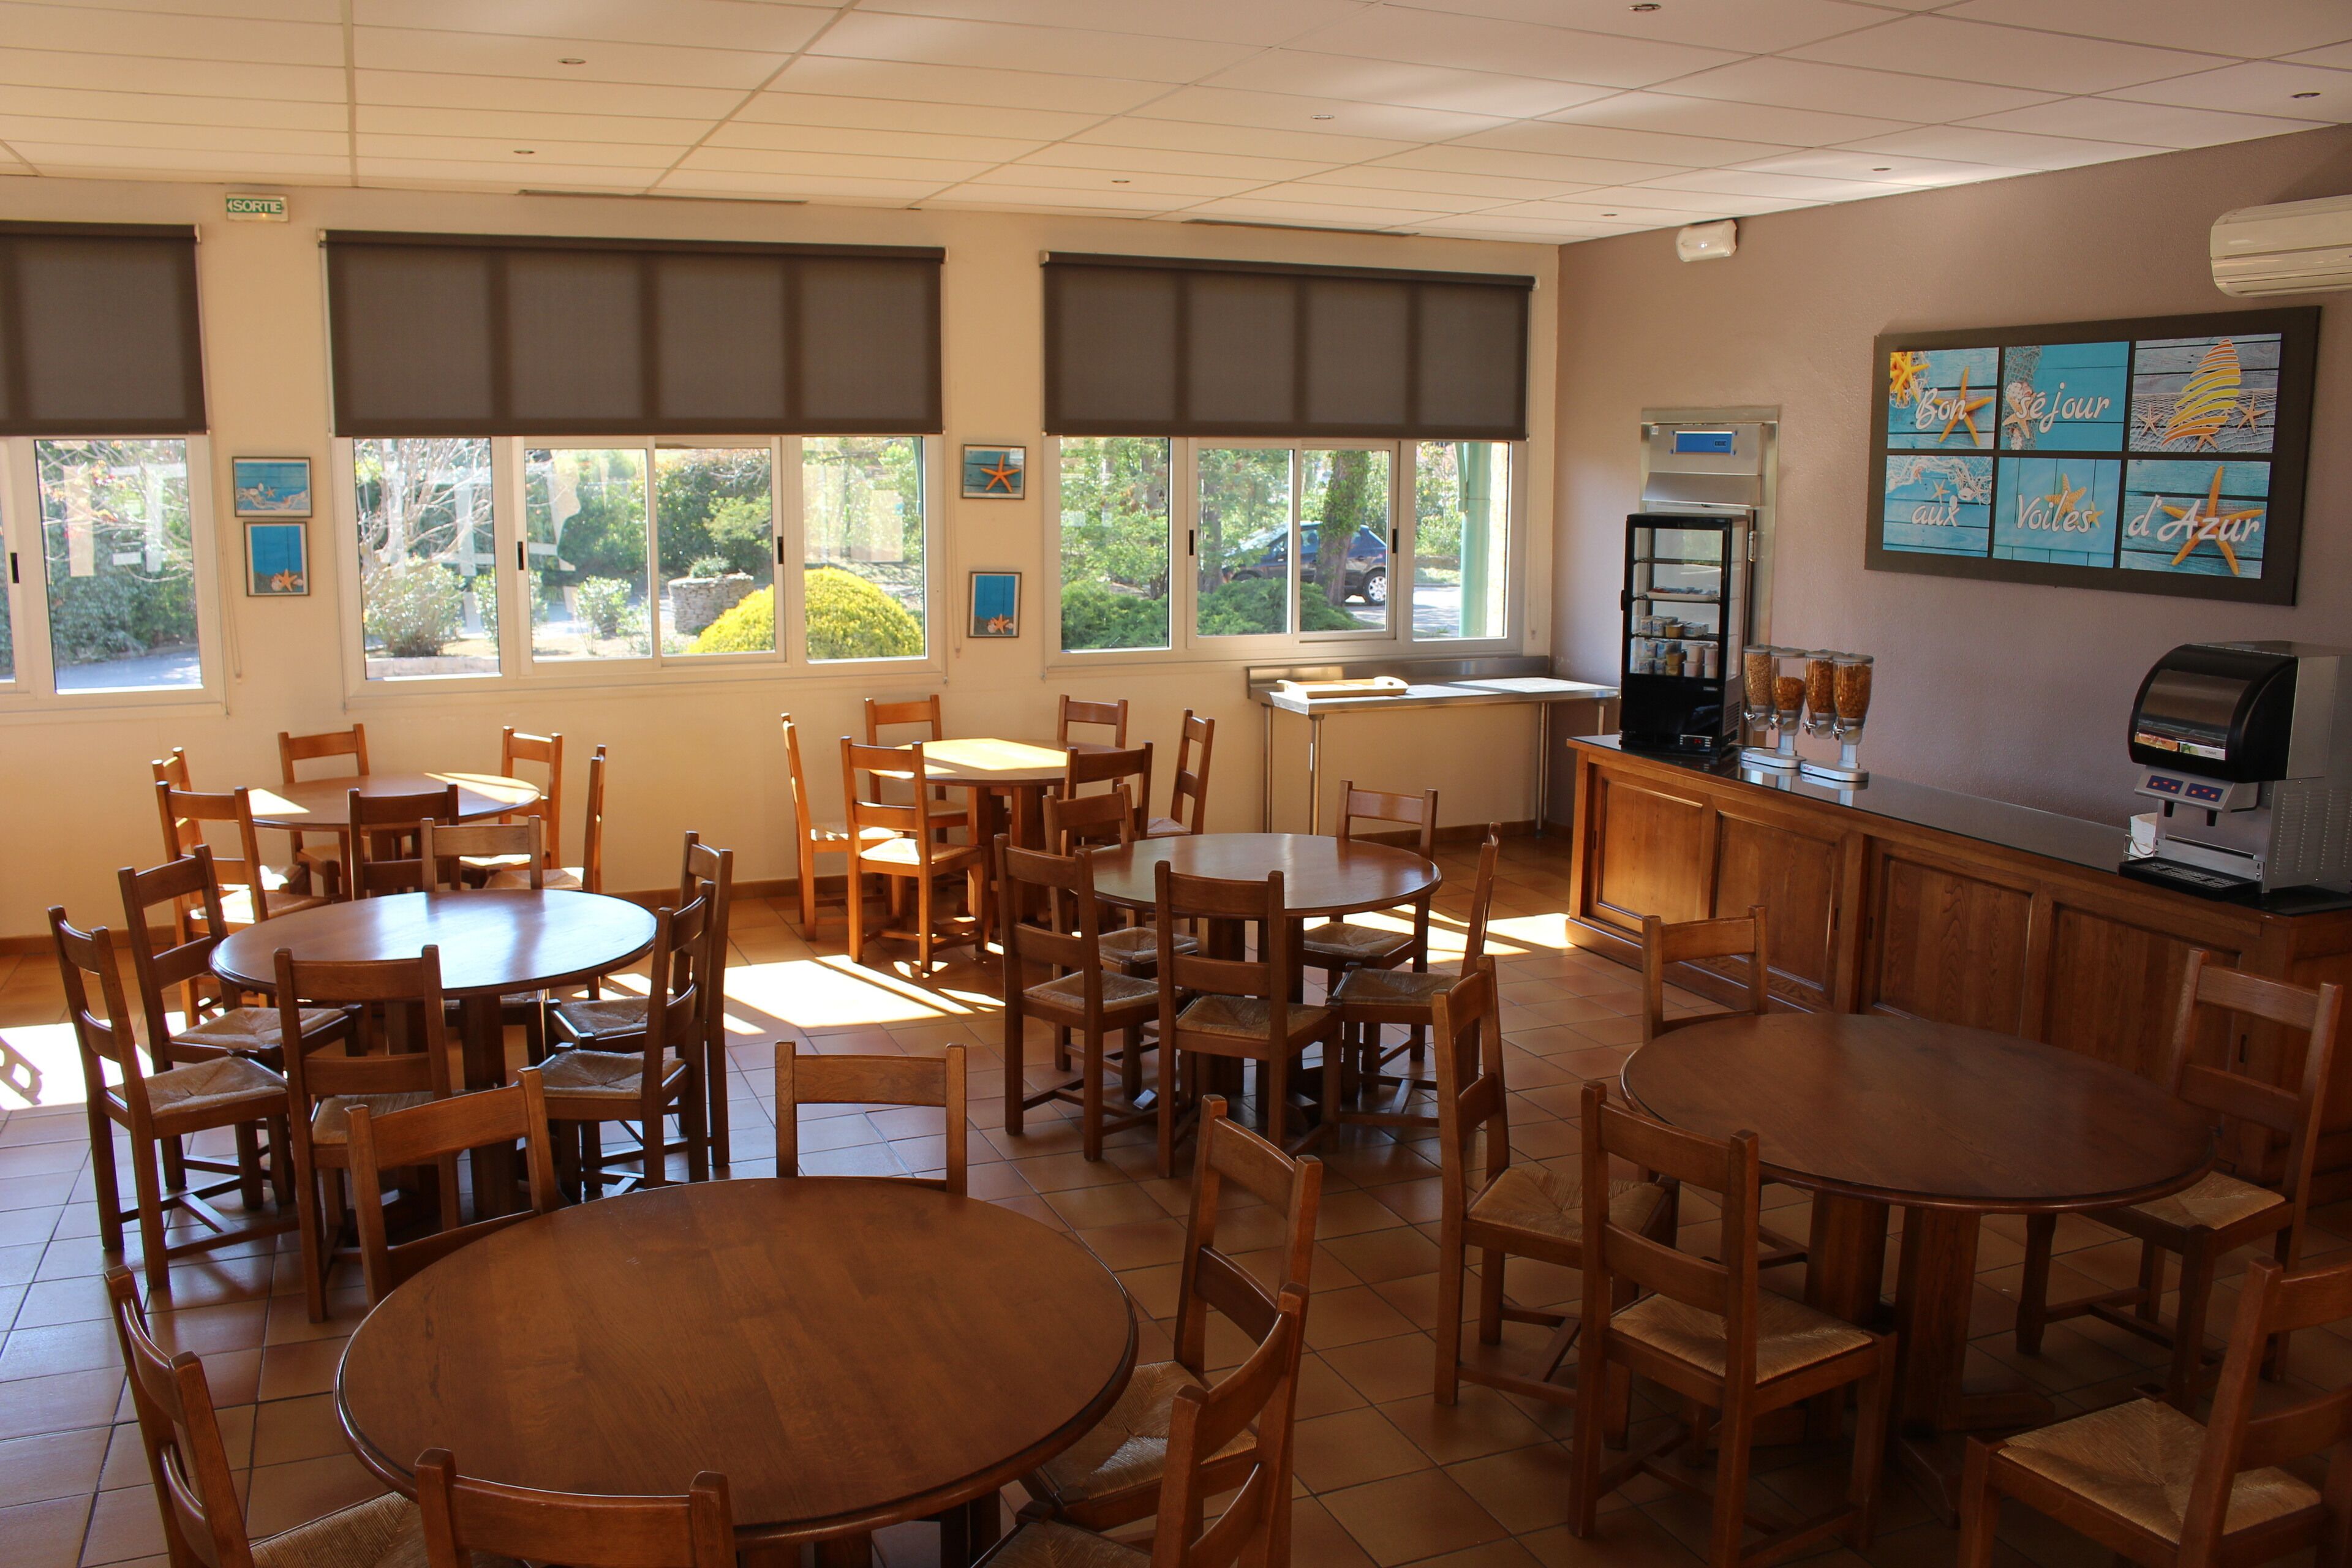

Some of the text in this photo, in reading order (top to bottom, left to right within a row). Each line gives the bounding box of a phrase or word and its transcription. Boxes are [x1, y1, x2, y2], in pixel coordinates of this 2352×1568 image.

[233, 200, 282, 213] SORTIE
[1915, 382, 2110, 434] Bon séjour
[1912, 490, 2260, 542] aux Voiles d'Azur
